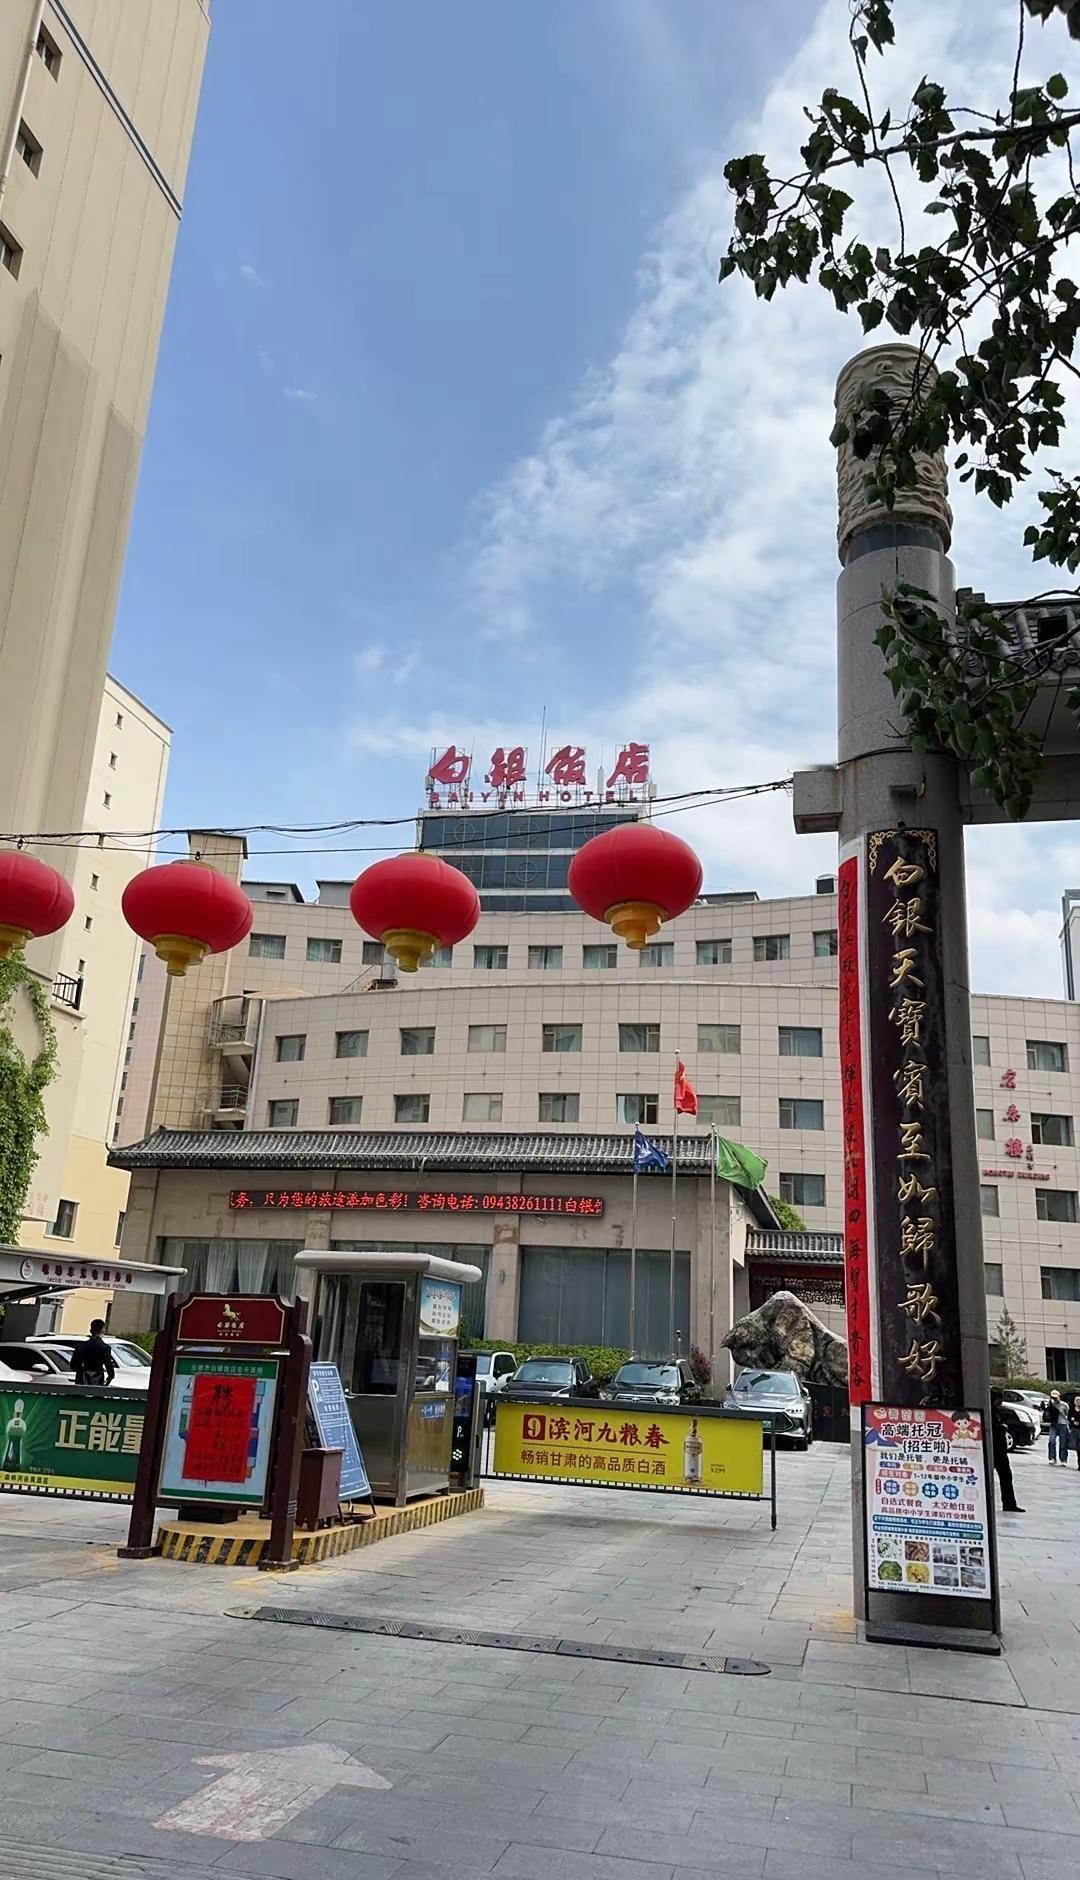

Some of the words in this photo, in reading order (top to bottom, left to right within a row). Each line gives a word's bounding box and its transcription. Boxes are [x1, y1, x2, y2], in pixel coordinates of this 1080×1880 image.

[429, 743, 650, 788] 白银饭店
[538, 789, 639, 803] HOTEL
[881, 855, 947, 1406] 白銀天寶賓至如歸歌好
[55, 1409, 145, 1454] 正能量
[548, 1417, 671, 1449] 滨河九粮春
[520, 1449, 667, 1476] 畅销甘肃的高品质白酒
